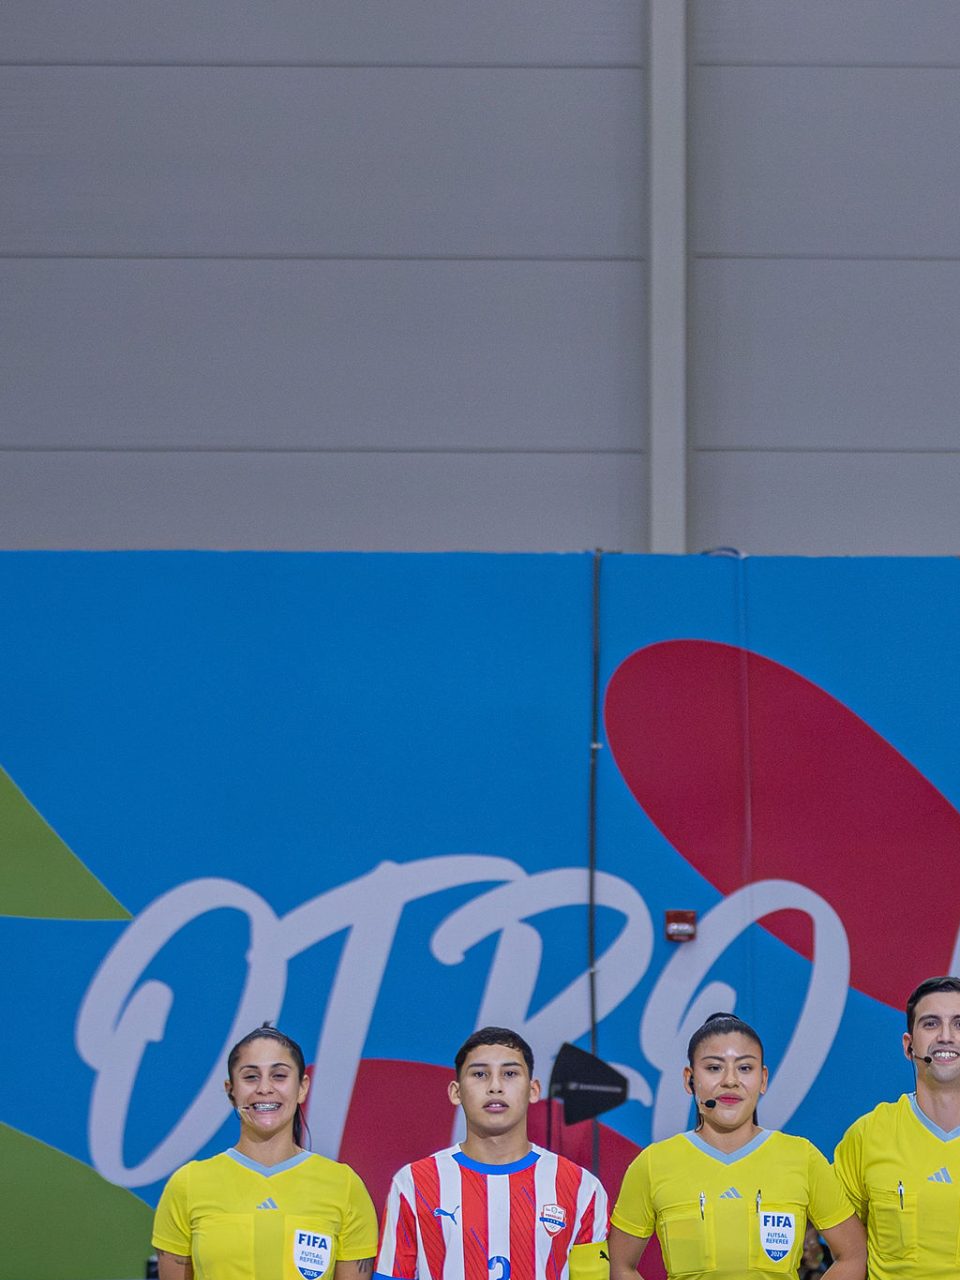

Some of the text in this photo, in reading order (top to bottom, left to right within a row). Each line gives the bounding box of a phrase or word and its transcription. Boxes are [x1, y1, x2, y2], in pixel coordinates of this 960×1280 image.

[75, 855, 850, 1188] OTRO
[763, 1215, 792, 1228] FIFA
[298, 1233, 328, 1250] FIFA
[299, 1256, 324, 1266] REFEREE
[301, 1250, 323, 1260] FUTSAL
